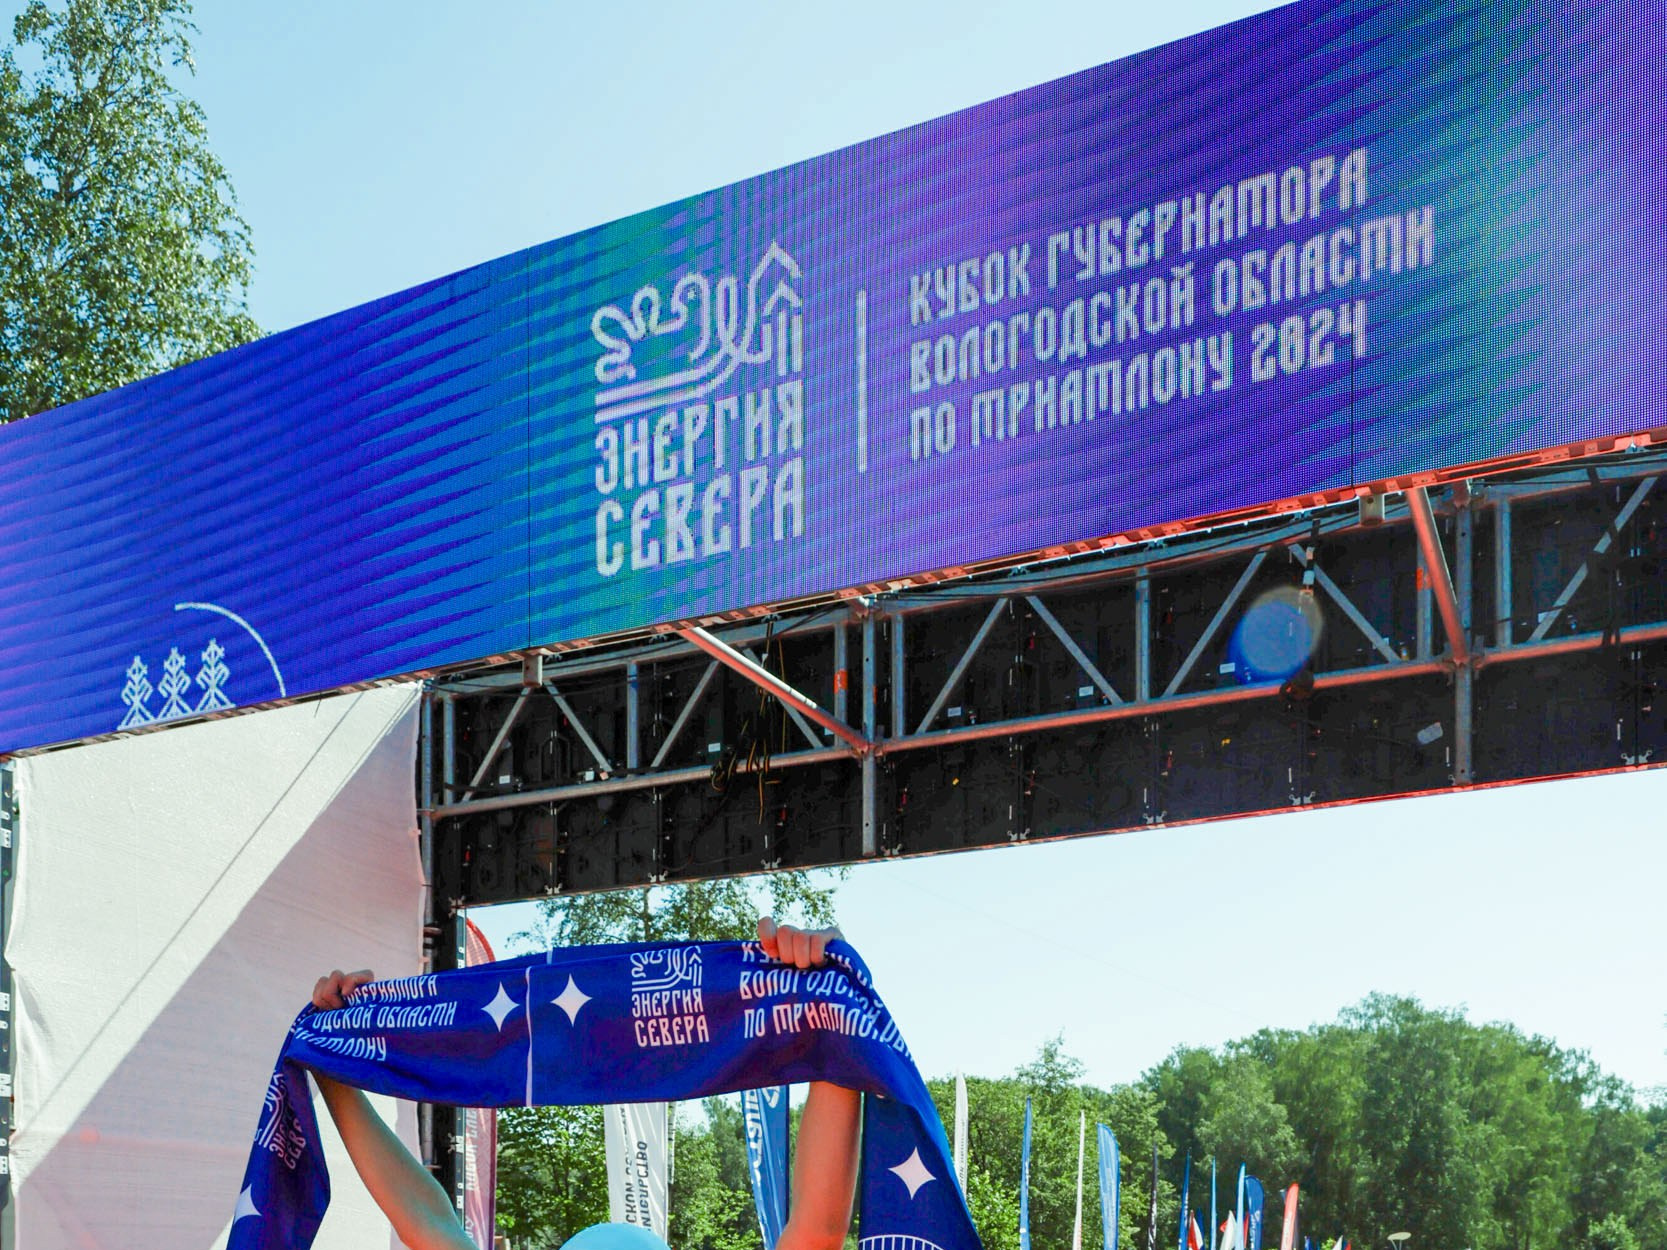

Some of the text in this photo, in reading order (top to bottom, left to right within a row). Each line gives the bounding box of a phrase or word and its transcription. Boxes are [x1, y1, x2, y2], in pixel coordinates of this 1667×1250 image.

[909, 149, 1370, 328] КУБОК ГУБЕРНАТОРА
[909, 205, 1437, 396] ВОЛОГОДСКОЙ ОБЛАСТИ
[594, 380, 805, 495] ЭНЕРГИЯ
[909, 301, 1369, 463] ПО ТРИАТЛОНУ 2024
[595, 458, 805, 579] СЕВЕРА
[377, 1001, 458, 1029] ОБЛАСТИ
[631, 988, 704, 1018] ЭНЕРГИЯ
[634, 1015, 710, 1047] СЕВЕРА
[744, 1007, 766, 1039] ПО
[772, 1003, 878, 1040] ТРИАТЛО
